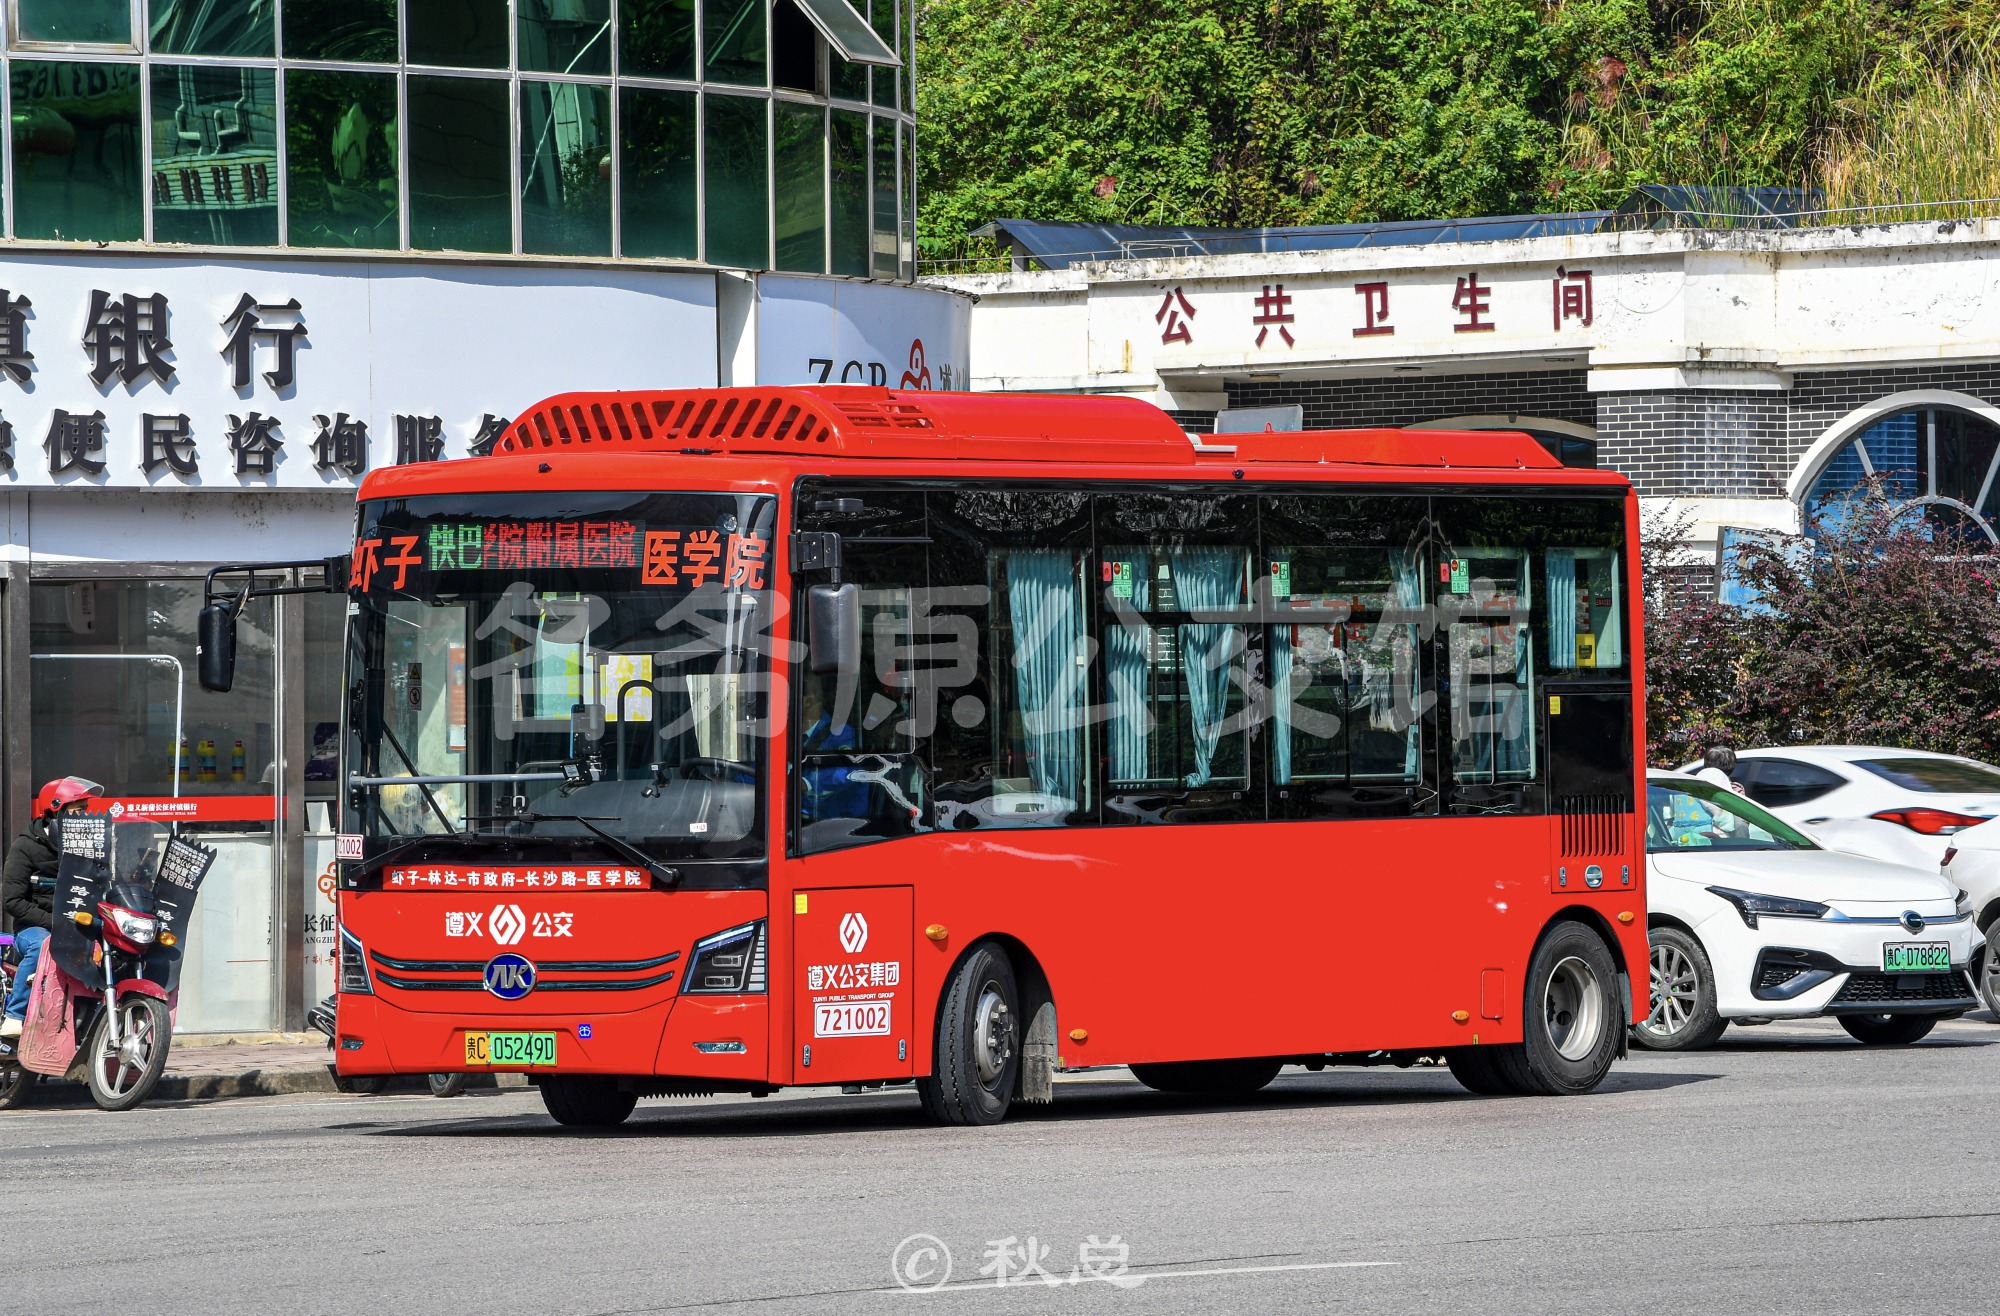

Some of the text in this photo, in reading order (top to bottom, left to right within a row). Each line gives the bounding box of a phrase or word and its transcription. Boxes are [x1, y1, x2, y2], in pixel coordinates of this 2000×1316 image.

[1155, 265, 1594, 349] 公共卫生间
[0, 407, 512, 476] 便民咨询服务
[348, 535, 423, 593] 虾子
[428, 523, 482, 571] 快巴
[641, 529, 767, 590] 医学院
[445, 911, 574, 937] 遵义 公交
[808, 961, 900, 991] 遵义公交集团
[821, 1006, 887, 1032] 721002
